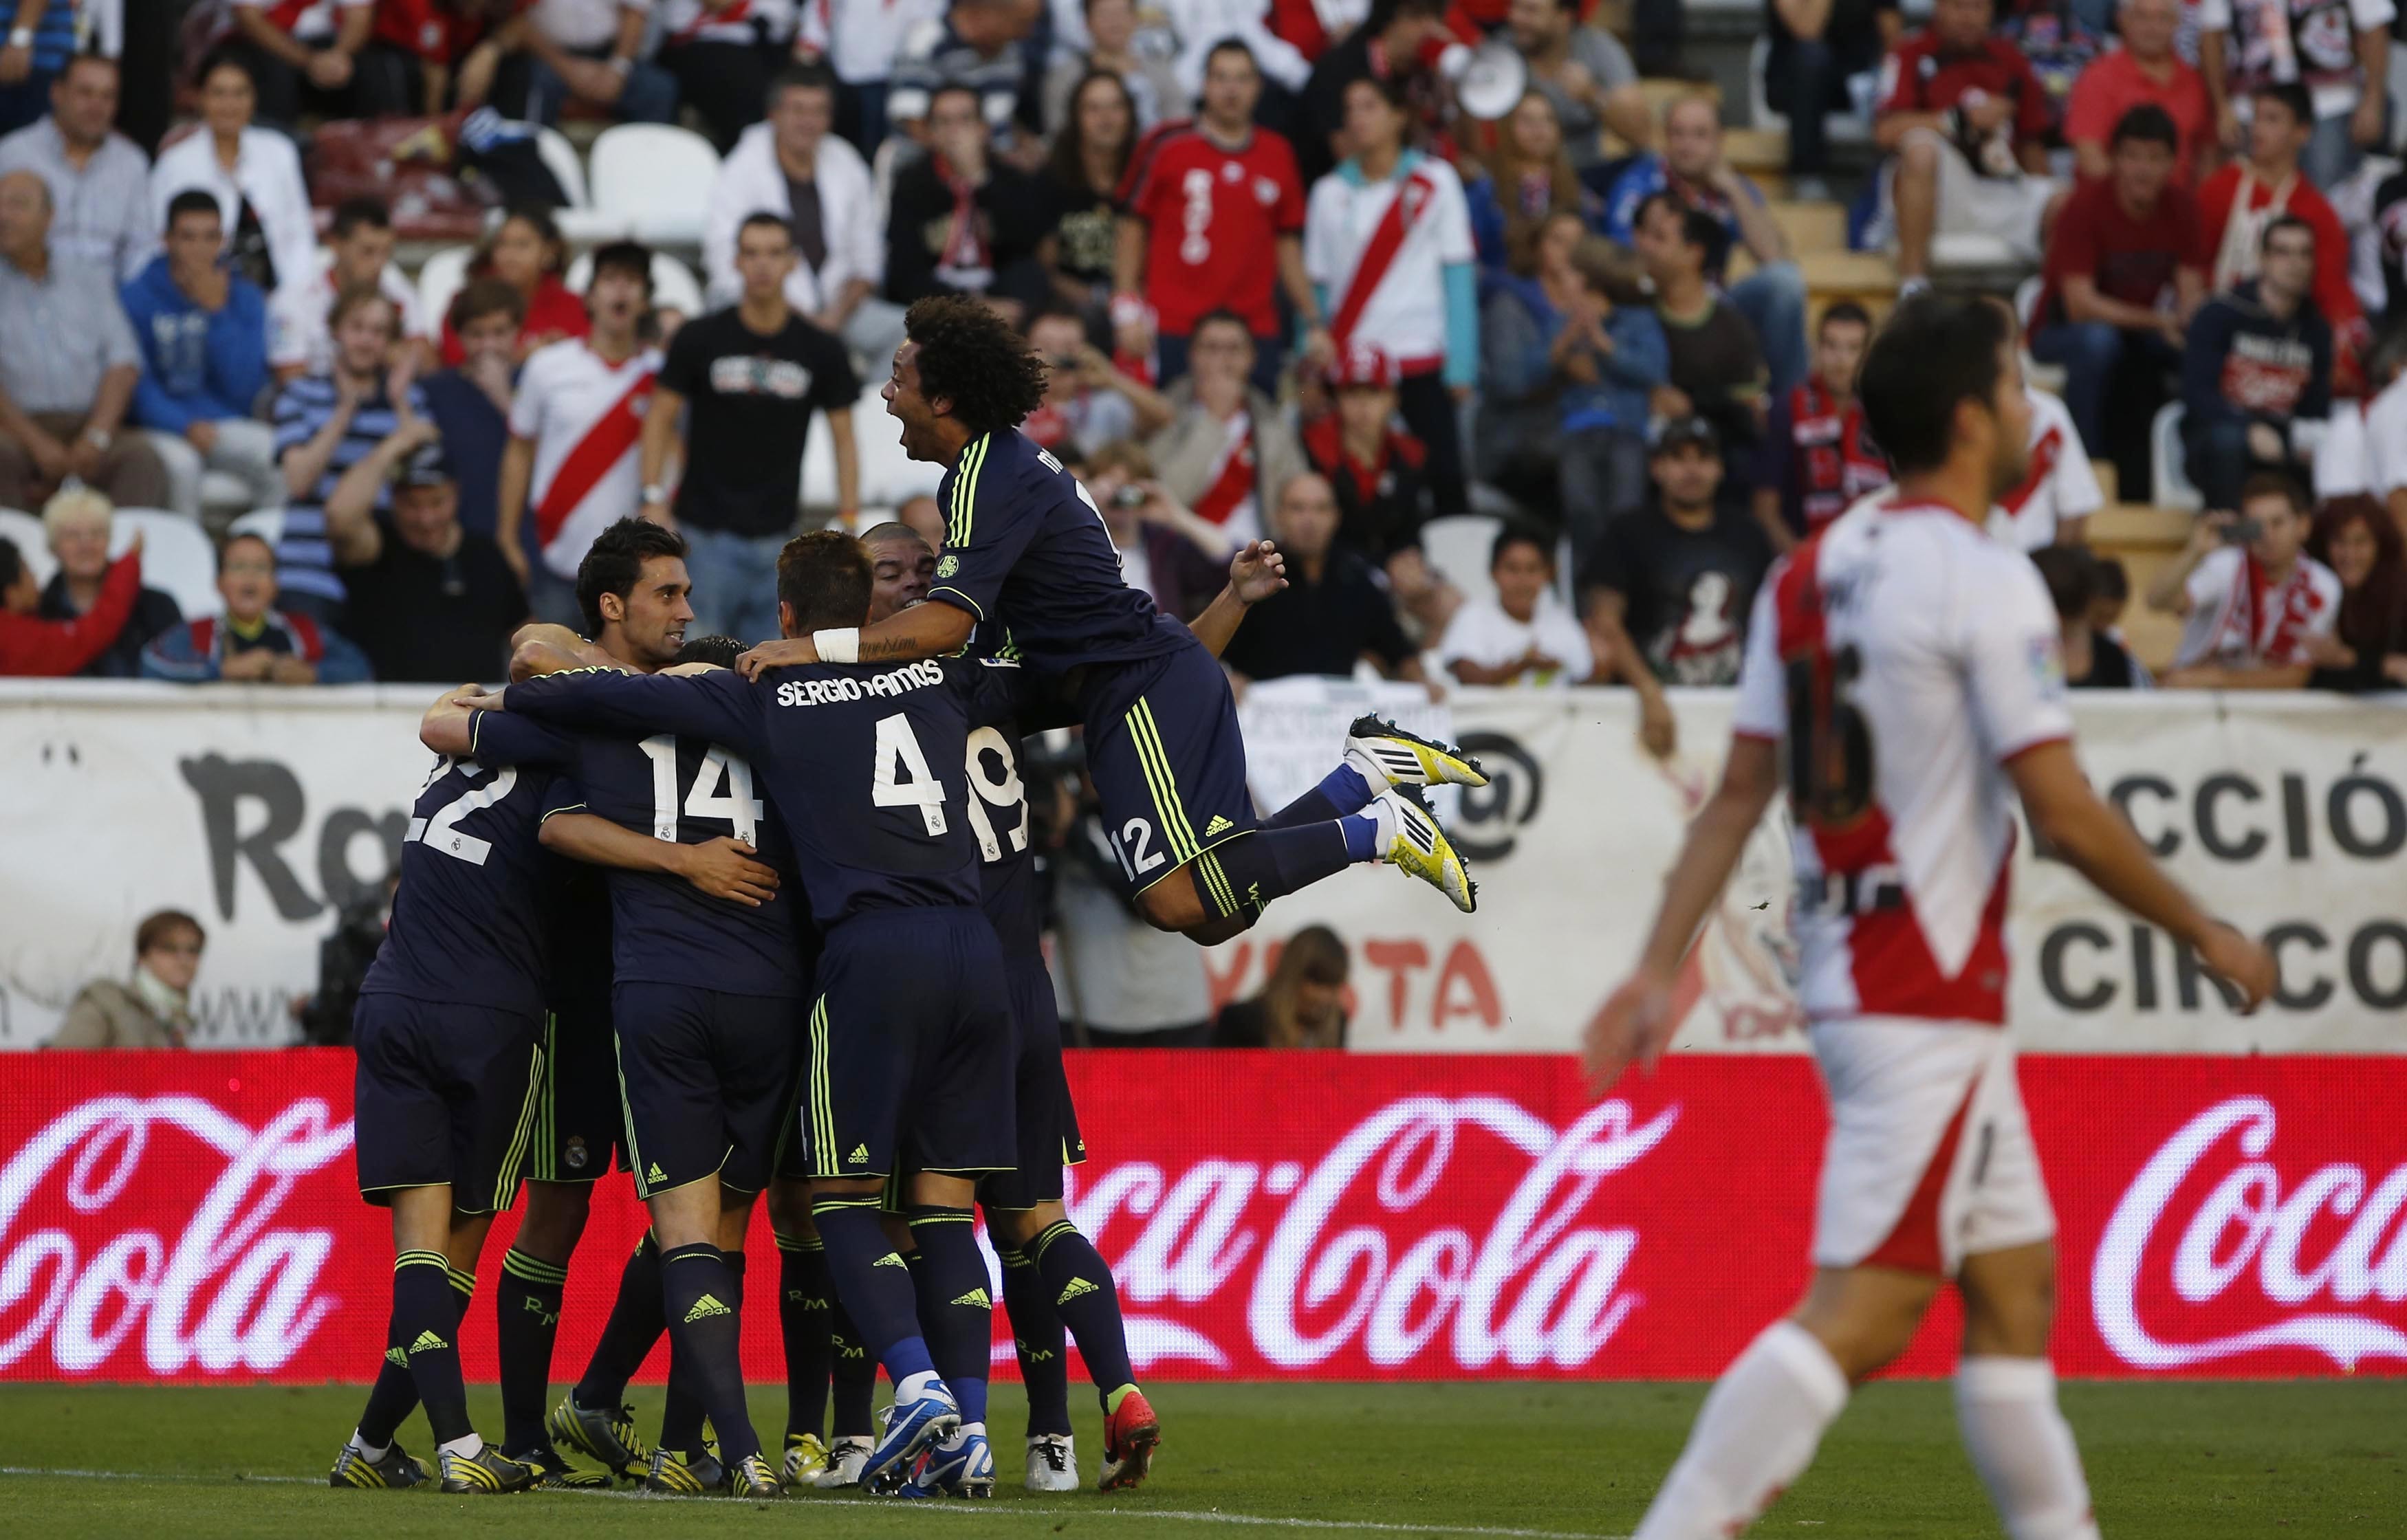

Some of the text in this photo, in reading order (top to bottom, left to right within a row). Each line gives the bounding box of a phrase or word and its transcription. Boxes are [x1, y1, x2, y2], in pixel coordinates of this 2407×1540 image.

[777, 677, 862, 707] SERGIO
[638, 734, 763, 848] 14
[872, 712, 946, 837] 4
[965, 726, 1030, 863] 19
[404, 754, 517, 866] 22
[1205, 820, 1234, 837] adidas
[2025, 749, 2407, 864] CCIÓ
[1111, 817, 1166, 883] 12
[647, 1174, 668, 1184] adidas
[684, 1305, 731, 1323] adidas
[1057, 1284, 1100, 1306] adidas
[409, 1341, 448, 1354] adidas
